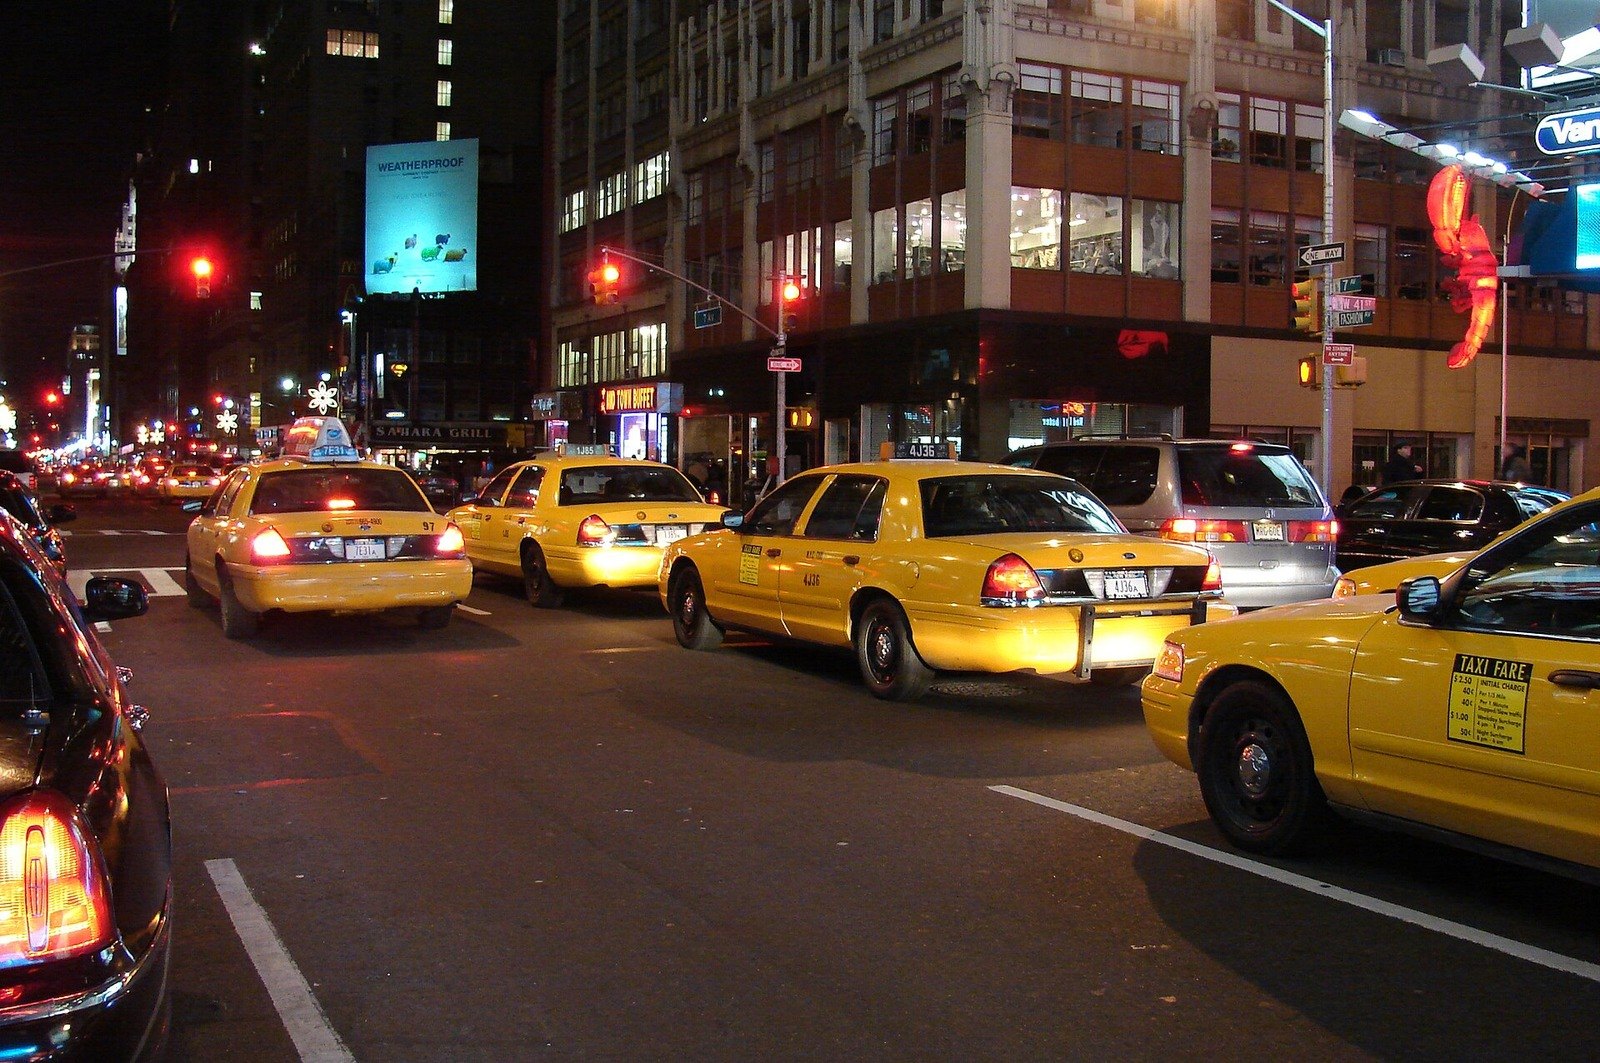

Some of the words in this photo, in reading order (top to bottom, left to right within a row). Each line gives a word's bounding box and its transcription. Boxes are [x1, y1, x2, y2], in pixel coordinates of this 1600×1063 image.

[378, 157, 465, 173] WEATHERPROOF
[1305, 251, 1319, 260] ONE
[1325, 249, 1339, 258] WAY
[1342, 280, 1348, 291] 7
[1343, 298, 1350, 309] W
[1354, 300, 1364, 310] 41
[1340, 312, 1364, 325] FASHION
[617, 389, 632, 410] TOWN
[633, 387, 655, 409] BUFFET
[376, 427, 442, 437] SAHARA
[449, 427, 492, 438] GRILL
[324, 446, 344, 456] 7E31
[909, 444, 935, 457] 4J36
[422, 521, 435, 532] 97
[803, 573, 820, 587] 4J36
[1460, 656, 1490, 675] TAXI
[1494, 661, 1527, 681] FARE
[1480, 680, 1501, 689] INITIAL
[1502, 682, 1526, 693] CHARGE
